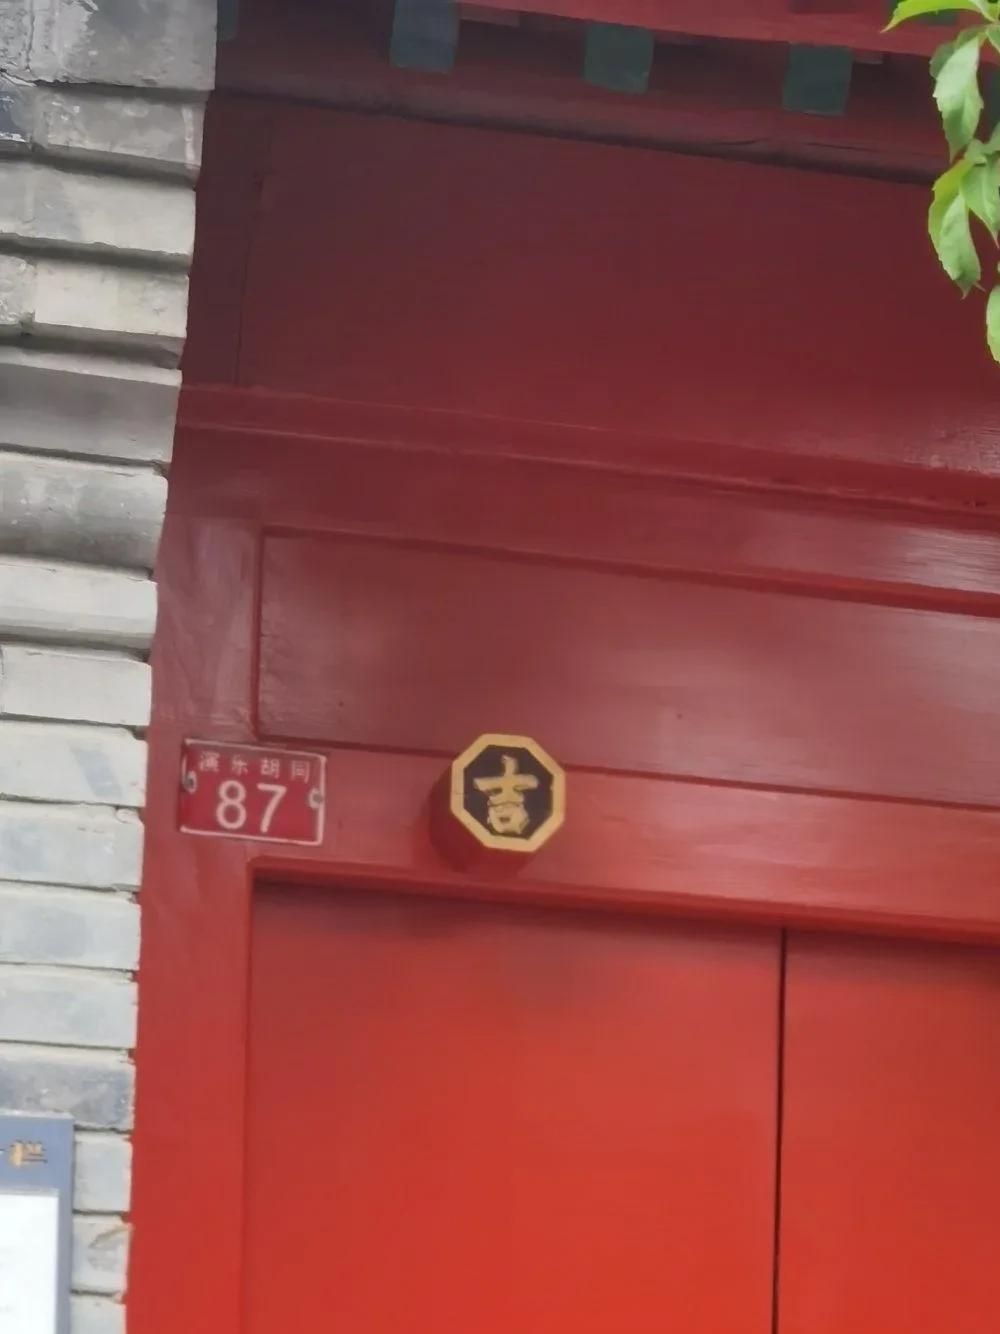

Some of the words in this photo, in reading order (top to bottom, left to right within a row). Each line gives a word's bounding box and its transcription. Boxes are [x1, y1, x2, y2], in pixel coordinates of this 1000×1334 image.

[198, 751, 311, 782] 演乐胡同
[215, 779, 288, 834] 87
[473, 755, 539, 835] 吉
